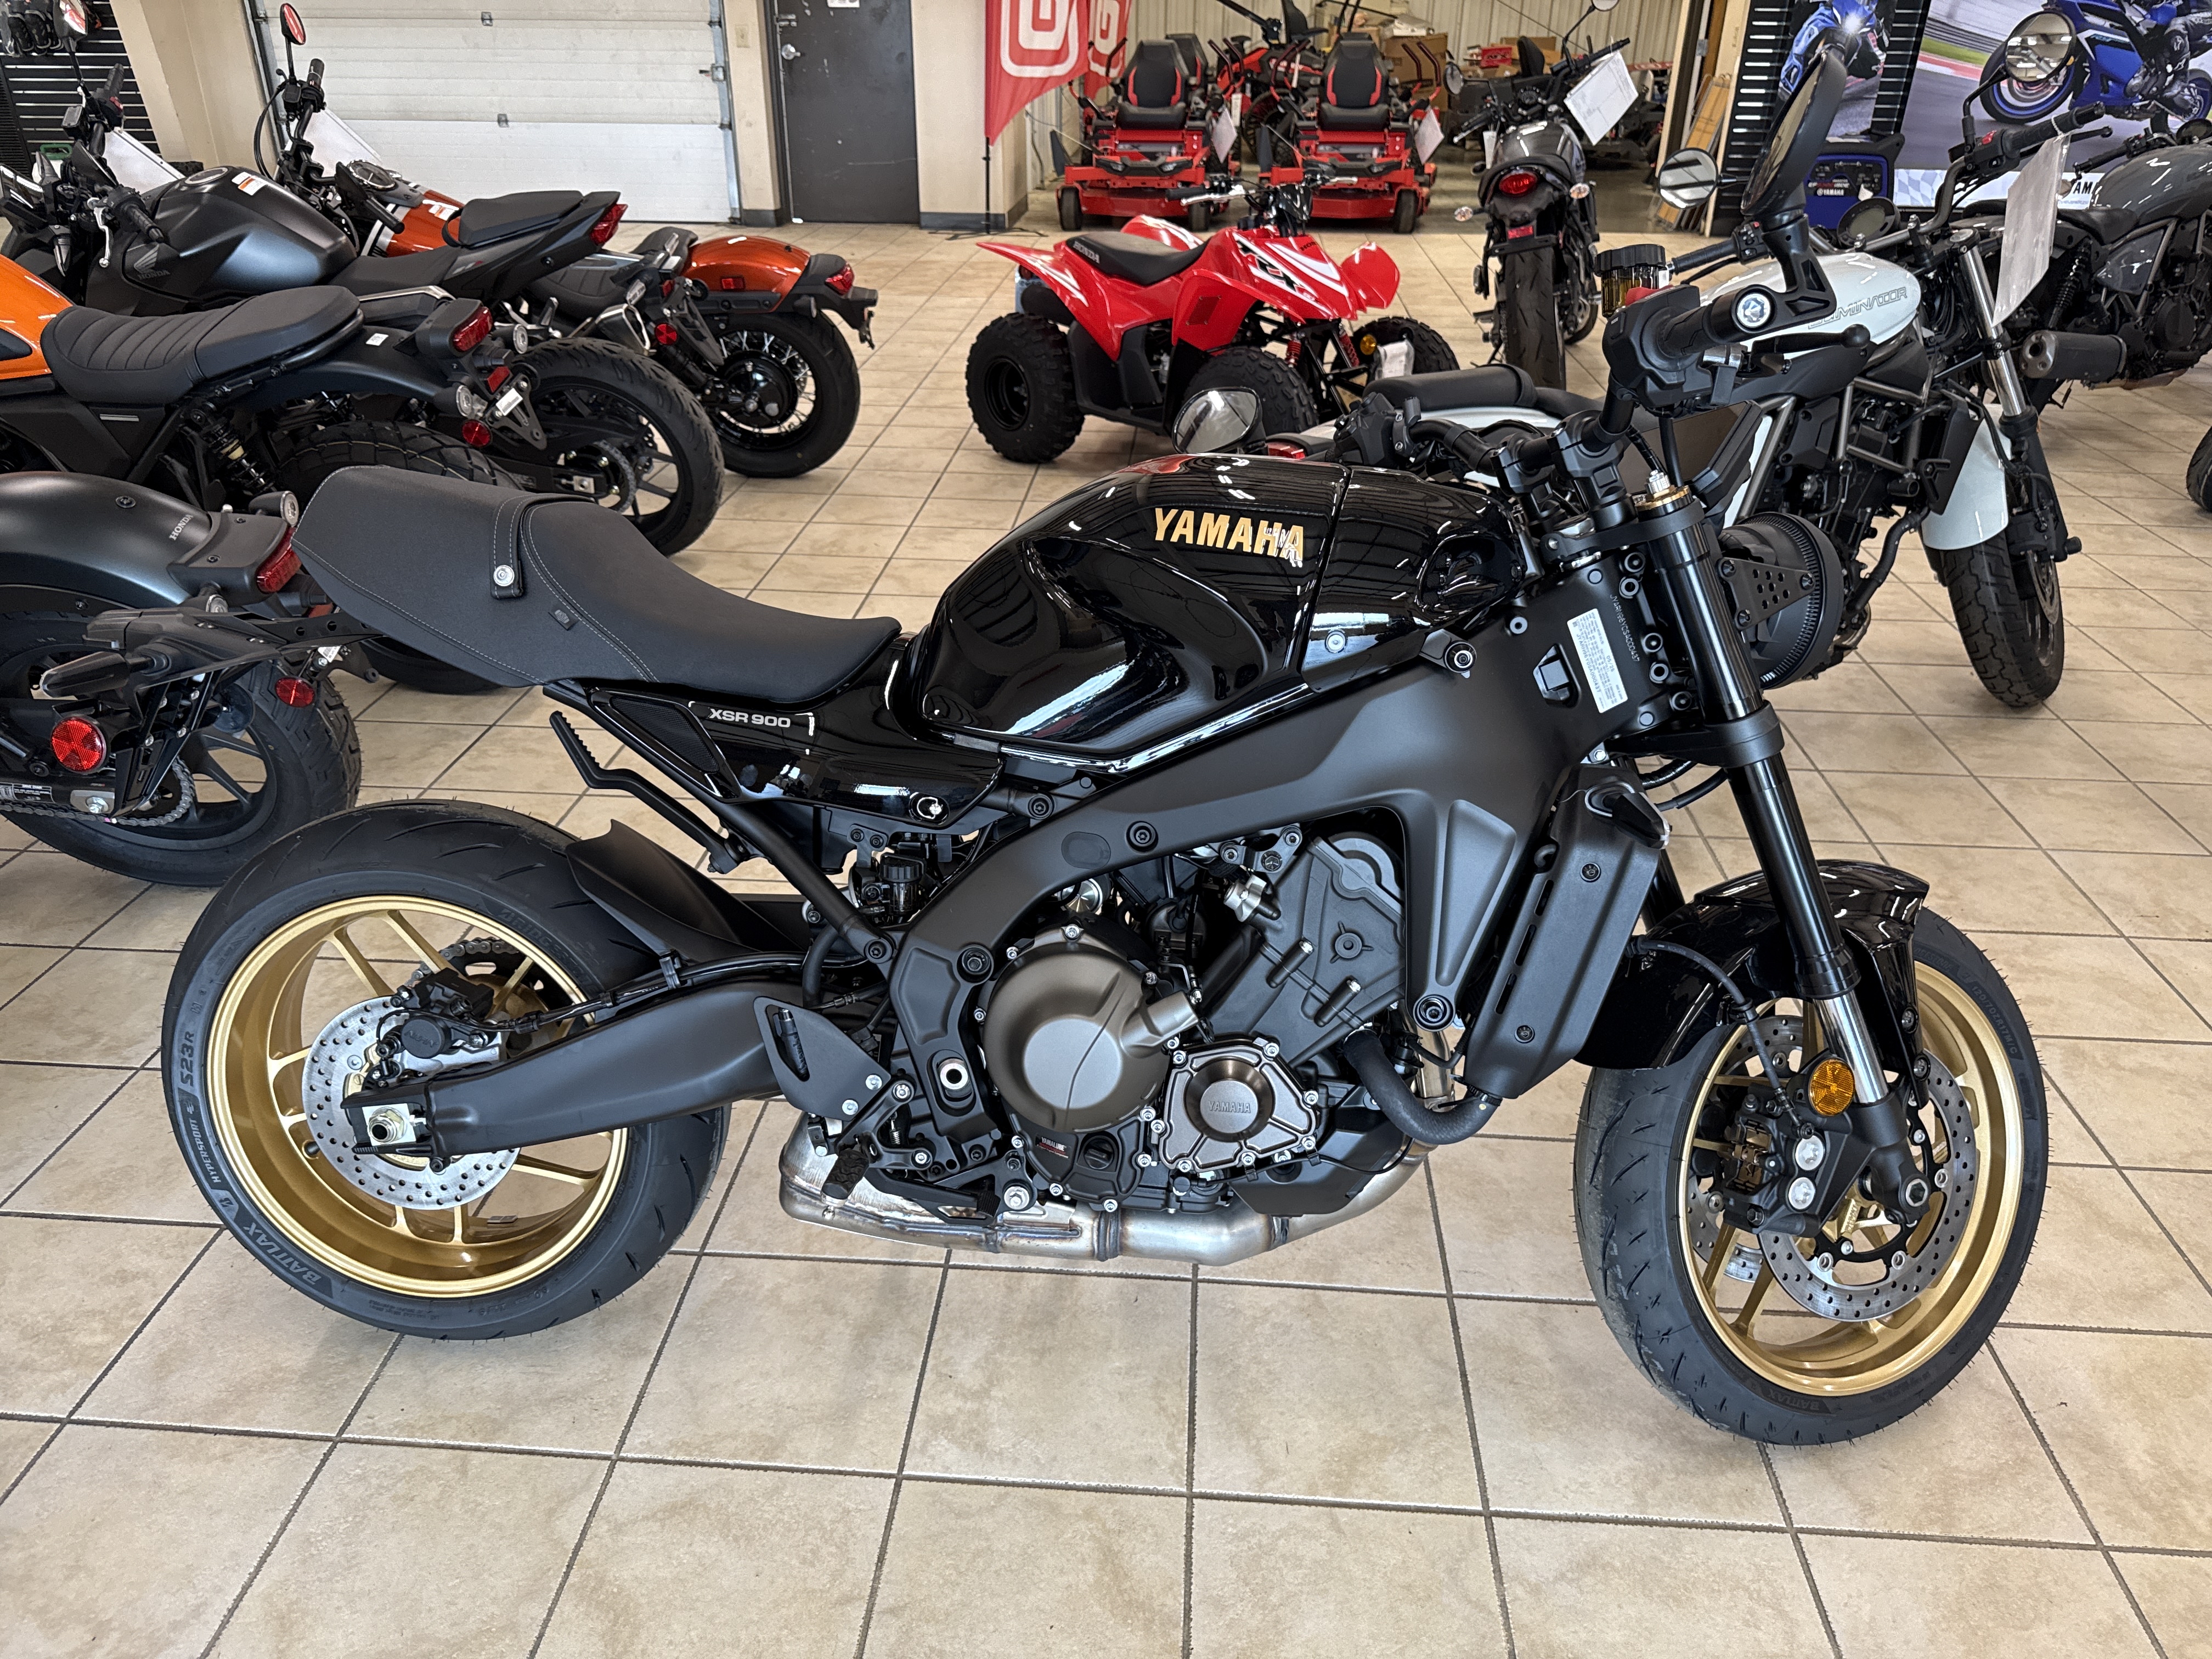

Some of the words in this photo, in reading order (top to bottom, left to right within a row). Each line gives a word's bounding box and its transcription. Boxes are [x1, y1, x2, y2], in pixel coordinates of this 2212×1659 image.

[1073, 241, 1100, 264] HONDA
[138, 269, 171, 280] HONDA
[1808, 286, 1907, 330] IMINATOR
[169, 514, 193, 540] HONDA
[1155, 507, 1304, 562] YAMAHA
[709, 708, 748, 723] XSR
[751, 714, 791, 728] 900
[1208, 1101, 1251, 1114] YAMAHA
[190, 1119, 221, 1183] HYPERSPORT
[242, 1222, 322, 1286] BATTLAX
[1769, 1387, 1820, 1410] BATTLAX
